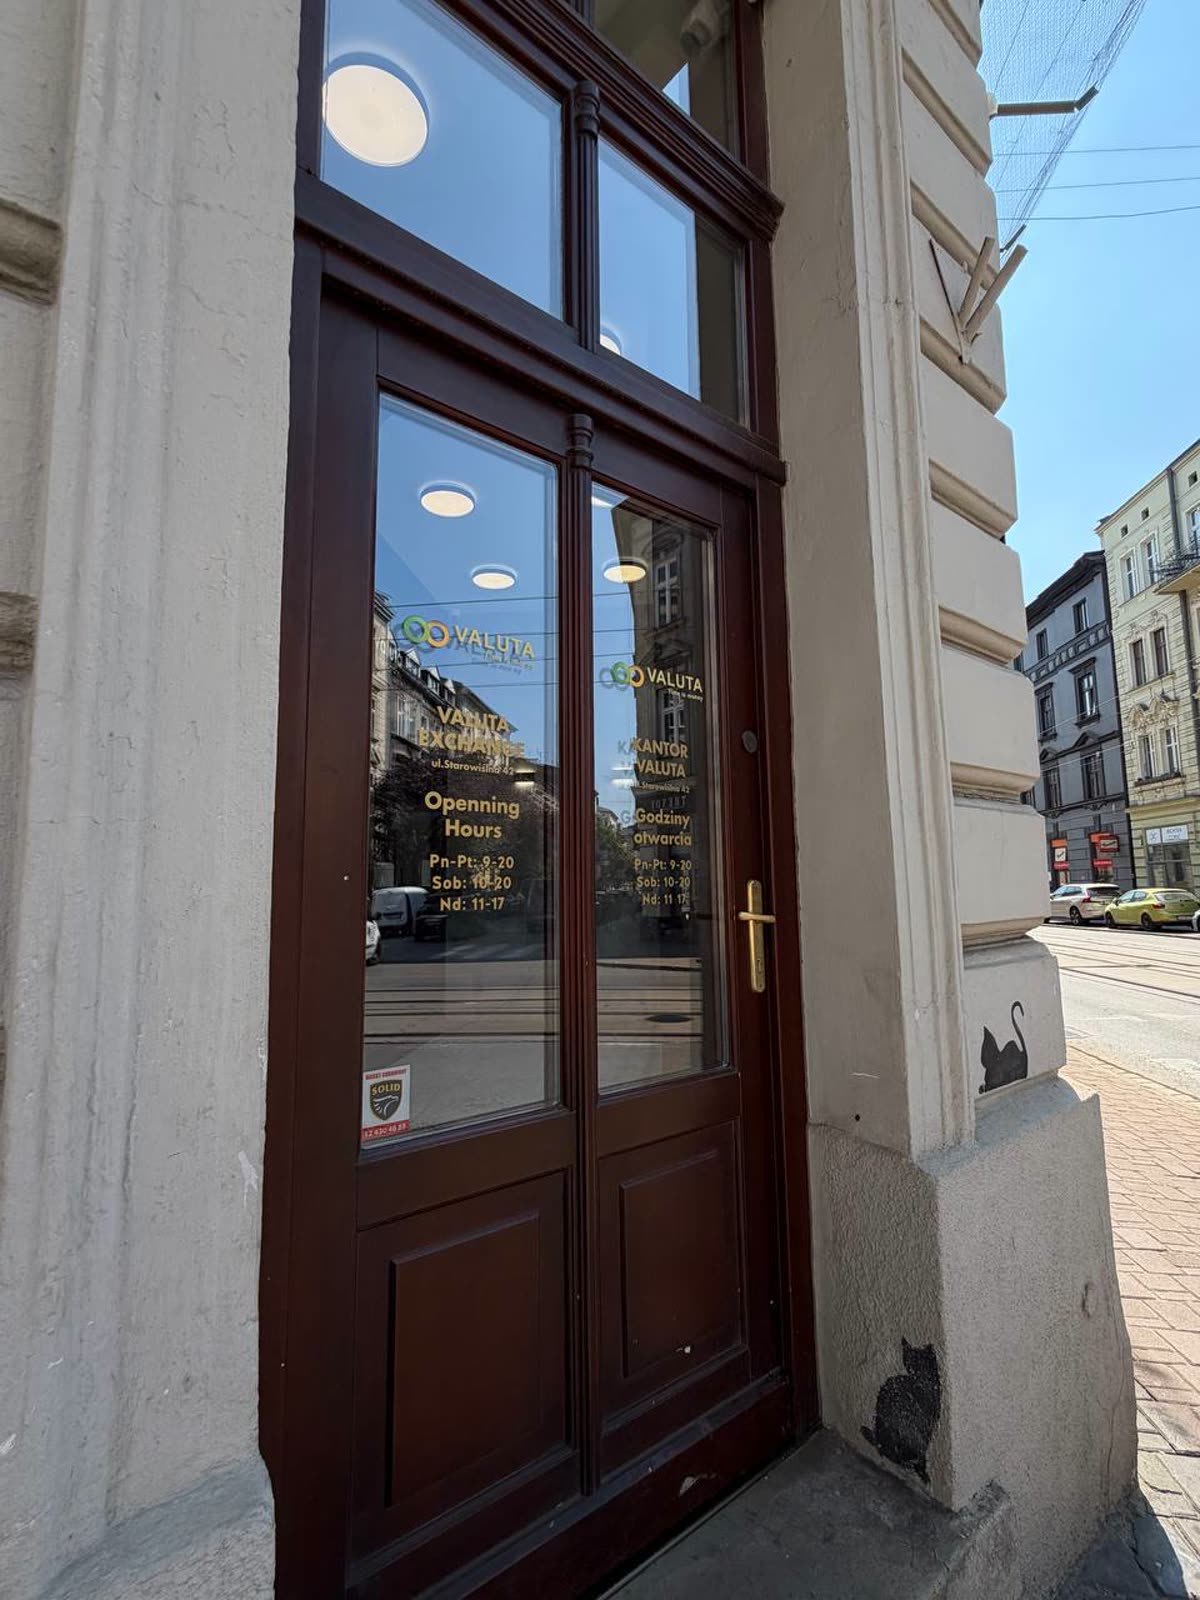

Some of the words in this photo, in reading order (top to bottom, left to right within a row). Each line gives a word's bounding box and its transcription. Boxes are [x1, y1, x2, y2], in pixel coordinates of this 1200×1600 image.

[454, 624, 535, 660] VALUTA
[646, 667, 703, 692] VALUTA
[634, 738, 689, 759] KANTOR
[637, 759, 686, 778] VALUTA
[424, 791, 520, 819] Openning
[635, 807, 690, 829] Godziny
[445, 819, 502, 838] Hours
[633, 830, 692, 847] otwarcia
[429, 853, 478, 869] Pn-Pt:
[482, 855, 515, 869] 9-20
[634, 859, 667, 871] Pn-Pt:
[669, 859, 692, 870] 9-20
[431, 875, 467, 890] Sob:
[472, 876, 513, 891] 10-20
[636, 875, 661, 888] Sob:
[663, 876, 691, 888] 10-20
[439, 896, 467, 911] Nd:
[471, 896, 506, 911] 11-17
[642, 893, 661, 905] Nd:
[372, 1083, 401, 1095] SOLID
